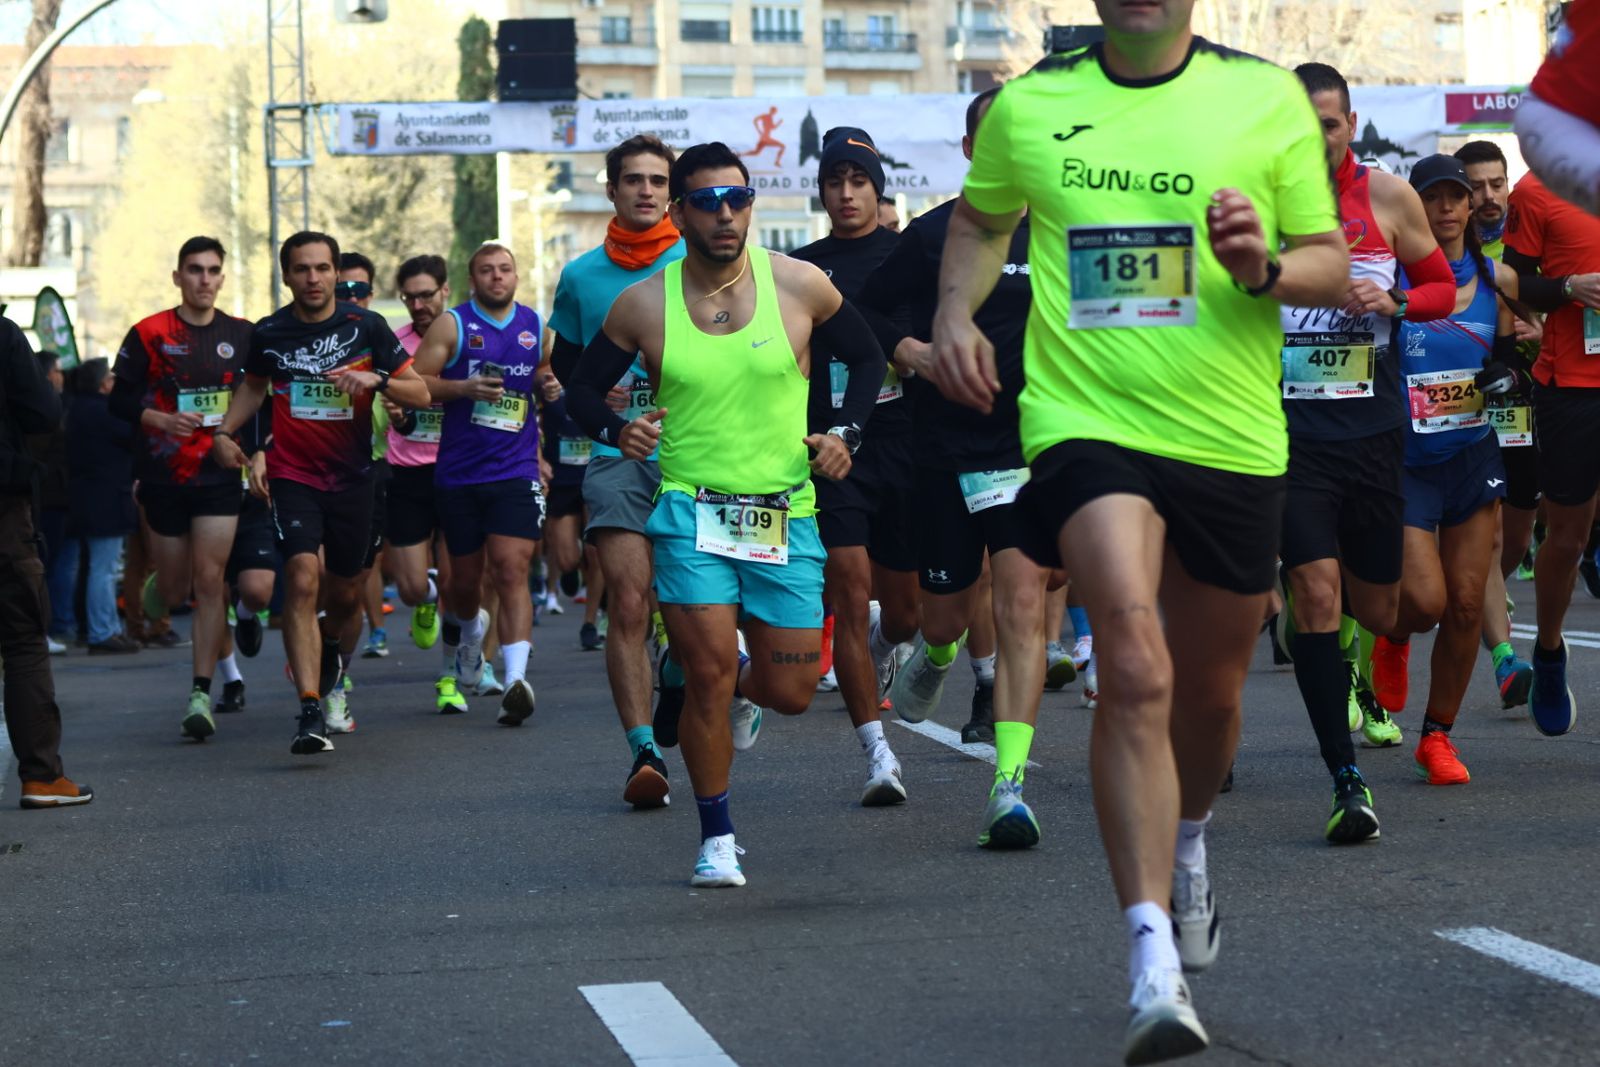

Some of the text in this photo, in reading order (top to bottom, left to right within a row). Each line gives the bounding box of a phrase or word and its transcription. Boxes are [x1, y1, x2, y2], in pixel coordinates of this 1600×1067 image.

[394, 111, 491, 130] Ayuntamiento
[593, 106, 689, 125] Ayuntamiento
[394, 131, 493, 148] de Salamanca
[593, 128, 609, 143] de
[1094, 252, 1159, 282] 181
[1308, 349, 1351, 367] 407
[503, 362, 534, 377] nder
[302, 384, 343, 399] 2165
[1426, 384, 1476, 404] 2324
[193, 394, 219, 408] 611
[715, 507, 773, 530] 1309
